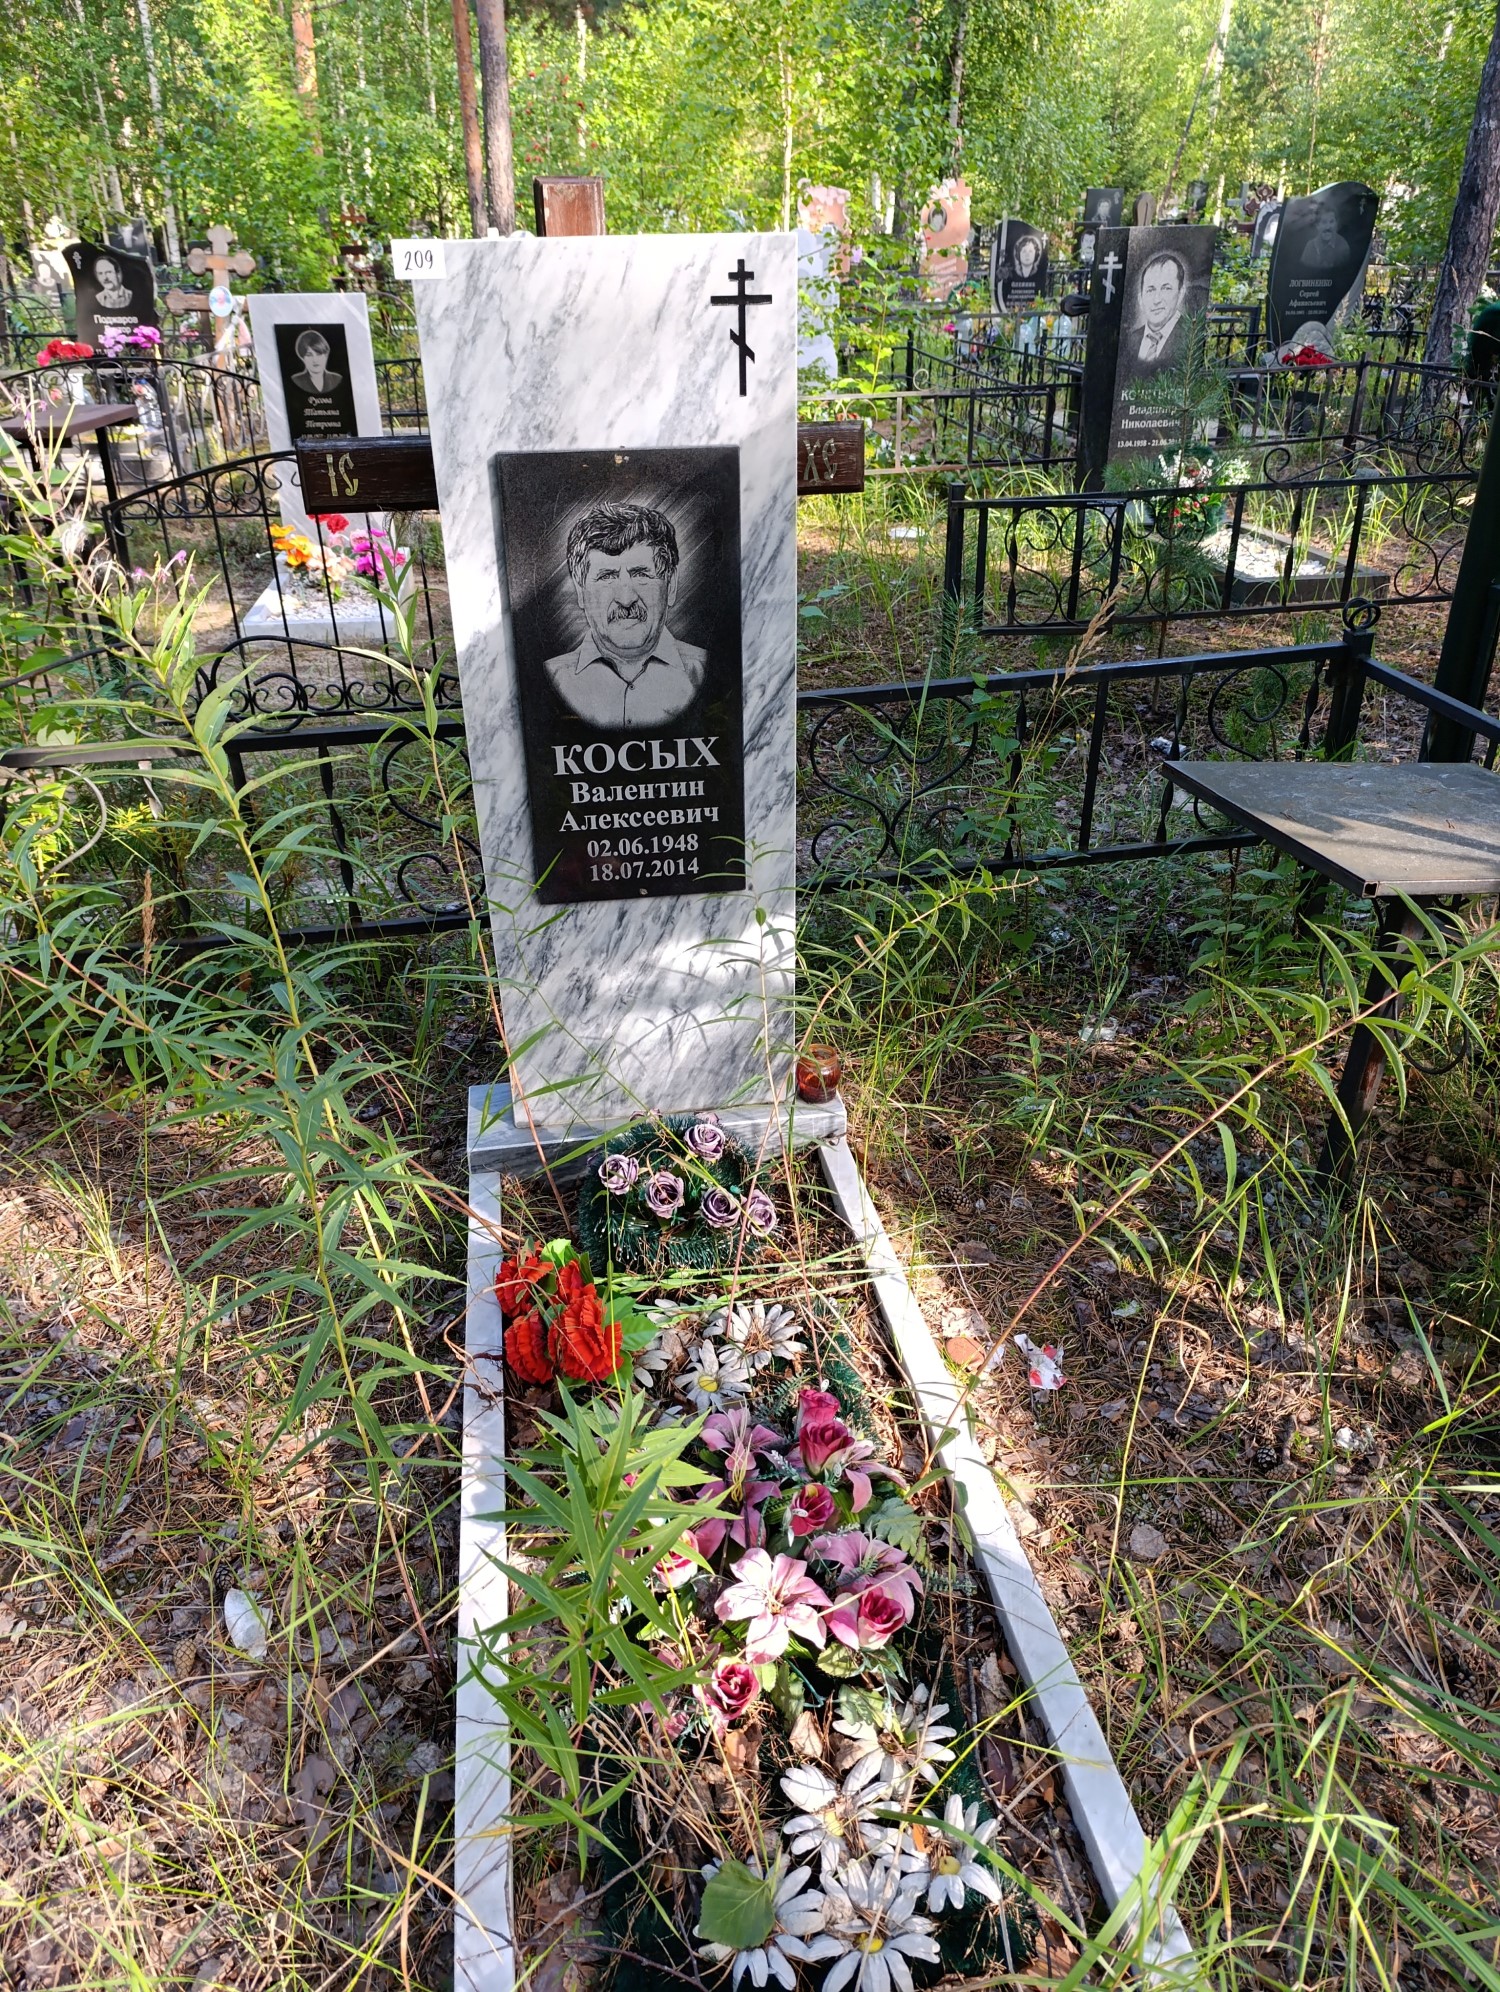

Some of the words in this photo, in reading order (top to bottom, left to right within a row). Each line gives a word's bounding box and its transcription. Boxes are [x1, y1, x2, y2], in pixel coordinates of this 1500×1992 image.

[404, 249, 434, 271] 209
[1121, 418, 1180, 430] Николаевич
[551, 736, 721, 776] КОСЫХ
[569, 780, 705, 804] Валентин
[558, 806, 720, 832] Алексеевич
[586, 833, 699, 858] 02.06.1948
[589, 857, 700, 882] 18.07.2014
